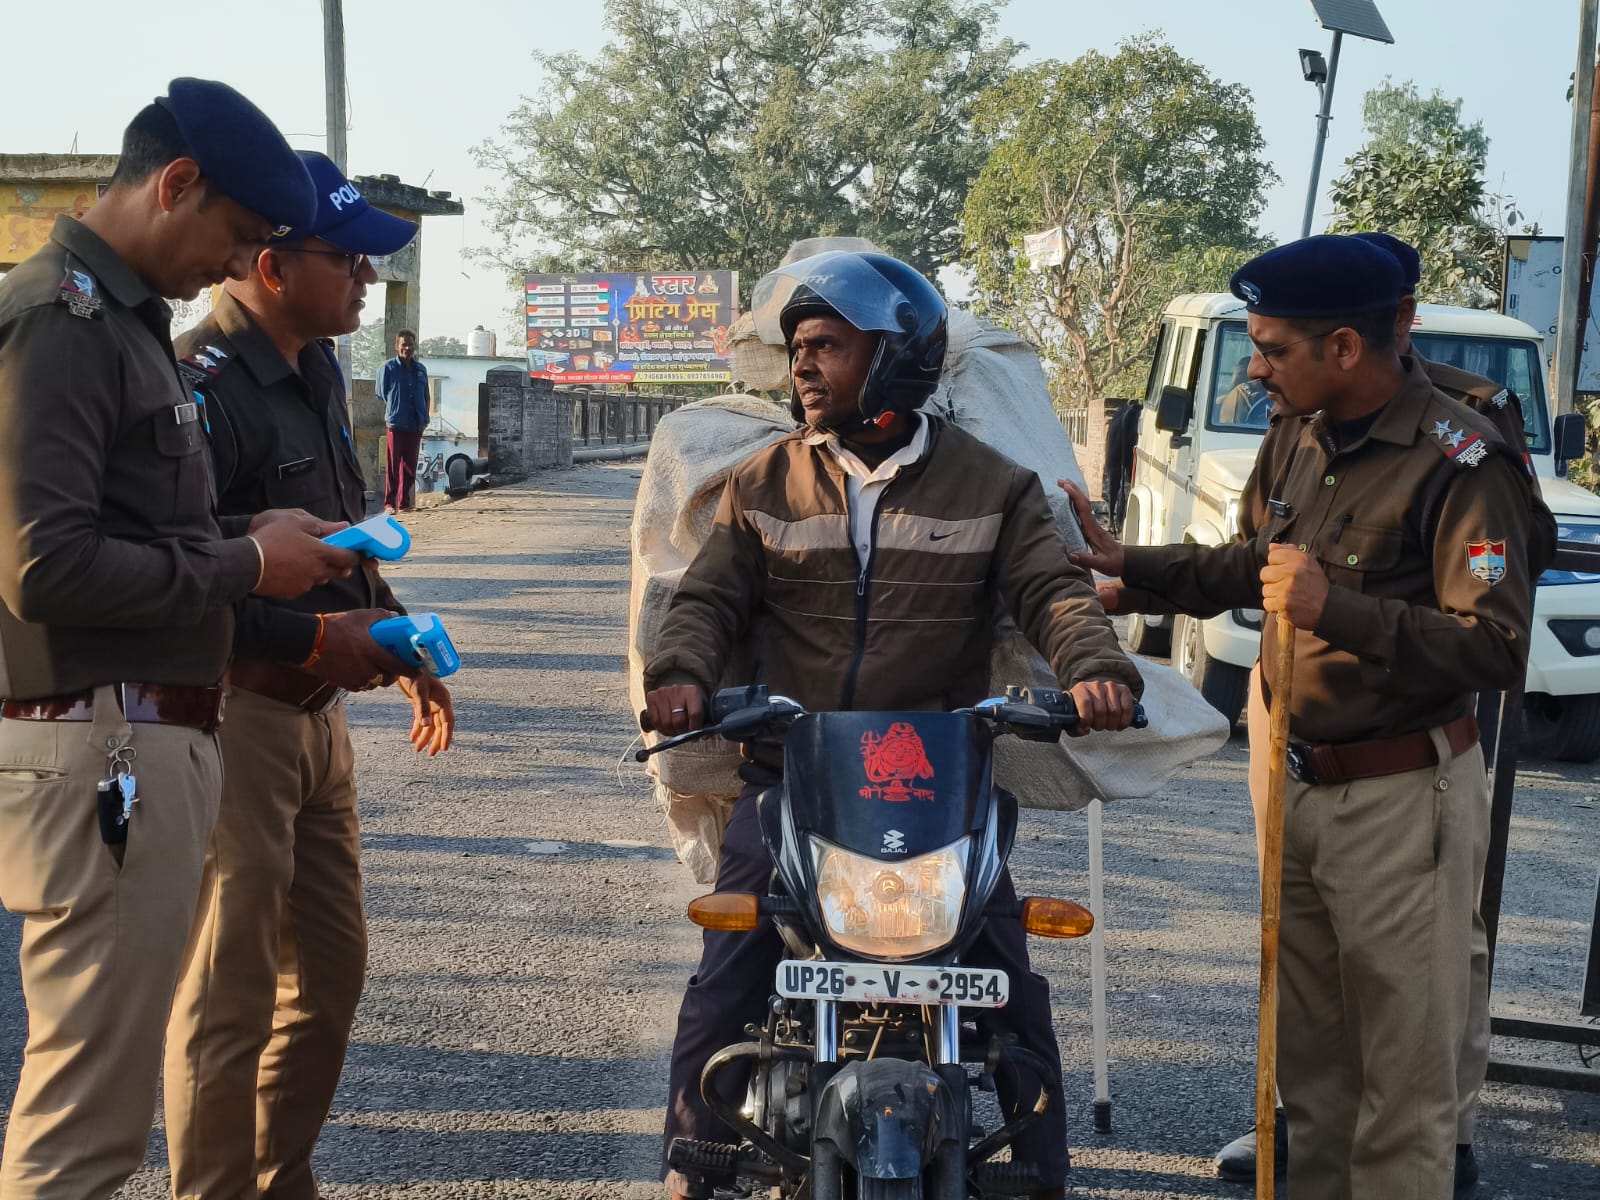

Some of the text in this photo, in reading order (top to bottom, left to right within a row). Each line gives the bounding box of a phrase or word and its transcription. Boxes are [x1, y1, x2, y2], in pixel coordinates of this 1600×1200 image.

[329, 181, 361, 211] POLI
[651, 276, 697, 295] स्टार
[681, 297, 720, 325] प्रेस
[785, 966, 1002, 1003] UP26 V 2954
